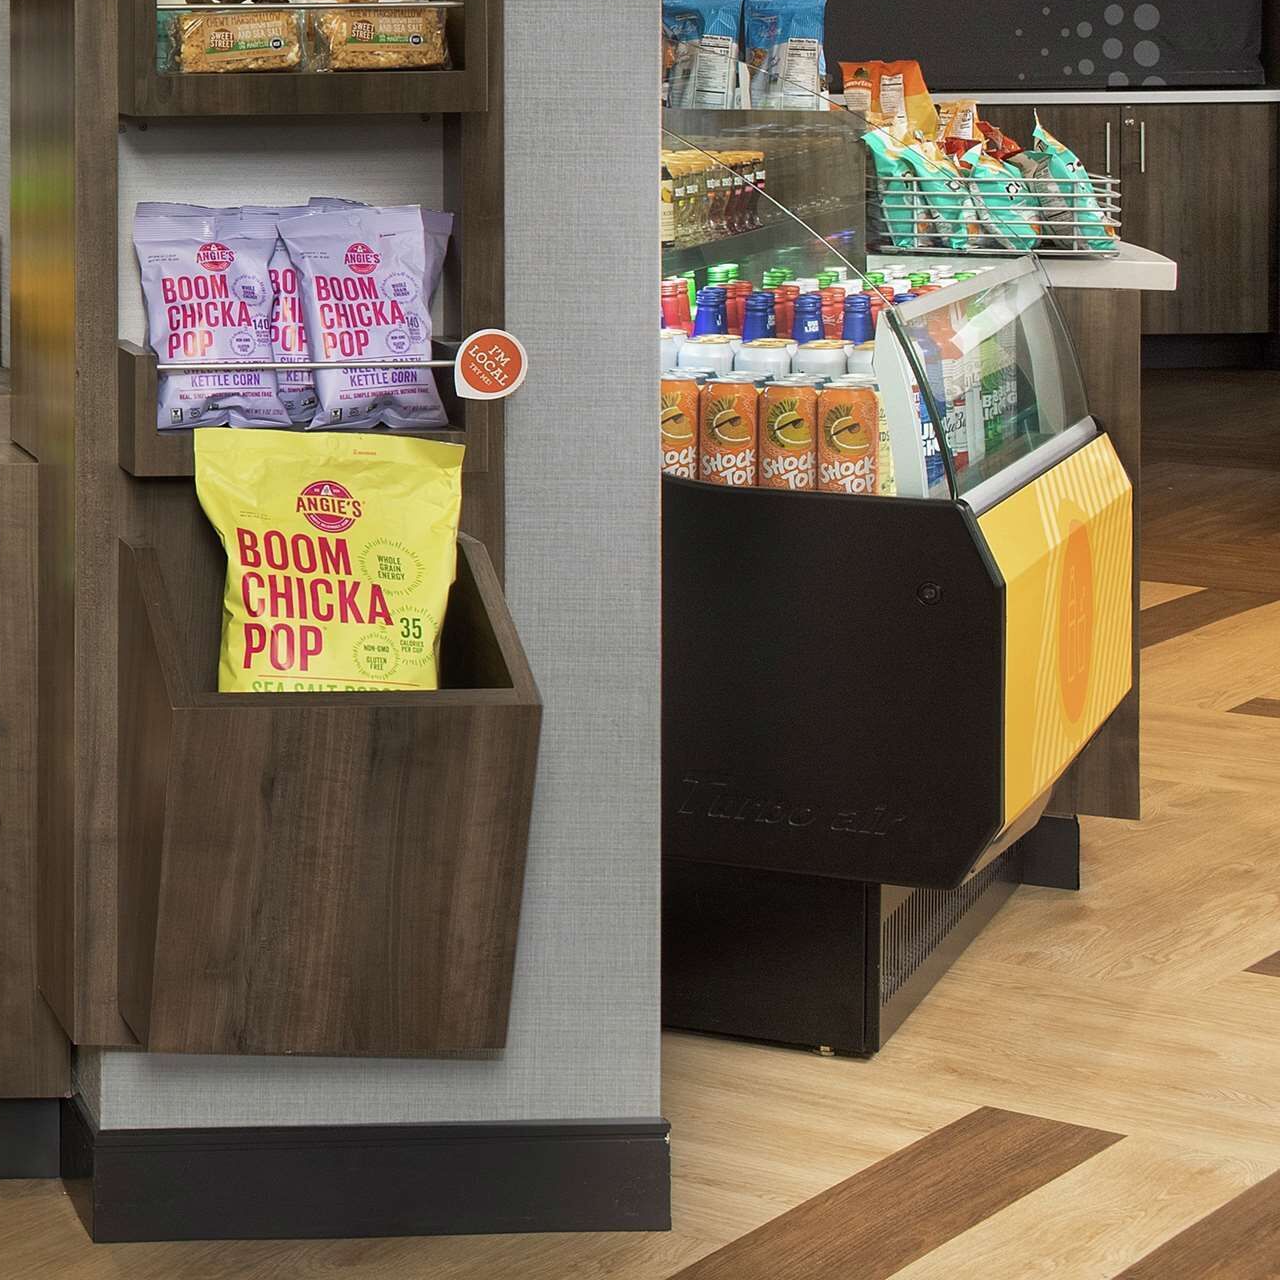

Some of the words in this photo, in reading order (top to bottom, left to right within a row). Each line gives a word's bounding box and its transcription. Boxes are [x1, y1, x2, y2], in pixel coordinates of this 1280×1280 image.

[210, 32, 233, 40] SWEET
[352, 31, 374, 40] STREET
[353, 22, 374, 31] SWEET
[210, 40, 233, 48] STREET
[196, 250, 235, 263] ANGIE'S
[344, 253, 381, 264] ANGIE'S
[161, 274, 229, 304] BOOM
[315, 276, 379, 301] BOOM
[167, 301, 252, 331] CHICKA
[319, 300, 406, 330] CHICKA
[168, 330, 214, 359] POP
[322, 329, 369, 359] POP
[468, 344, 509, 387] LOCAL
[488, 345, 511, 367] I'M
[191, 374, 231, 388] KETTLE
[233, 373, 260, 386] CORN
[350, 373, 388, 387] KETTLE
[391, 371, 418, 384] CORN
[702, 449, 755, 475] SHOCK
[762, 451, 816, 478] SHOCK
[820, 456, 876, 483] SHOCK
[720, 469, 756, 486] TOP
[840, 473, 876, 494] TOP
[296, 496, 363, 518] ANGIE'S
[237, 527, 352, 576] BOOM
[377, 555, 401, 565] WHOLE
[377, 570, 405, 581] ENERGY
[380, 563, 401, 572] GRAIN
[241, 571, 394, 626] CHICKA
[400, 617, 422, 639] 35
[243, 623, 324, 672] POP
[366, 657, 388, 665] GLUTEN
